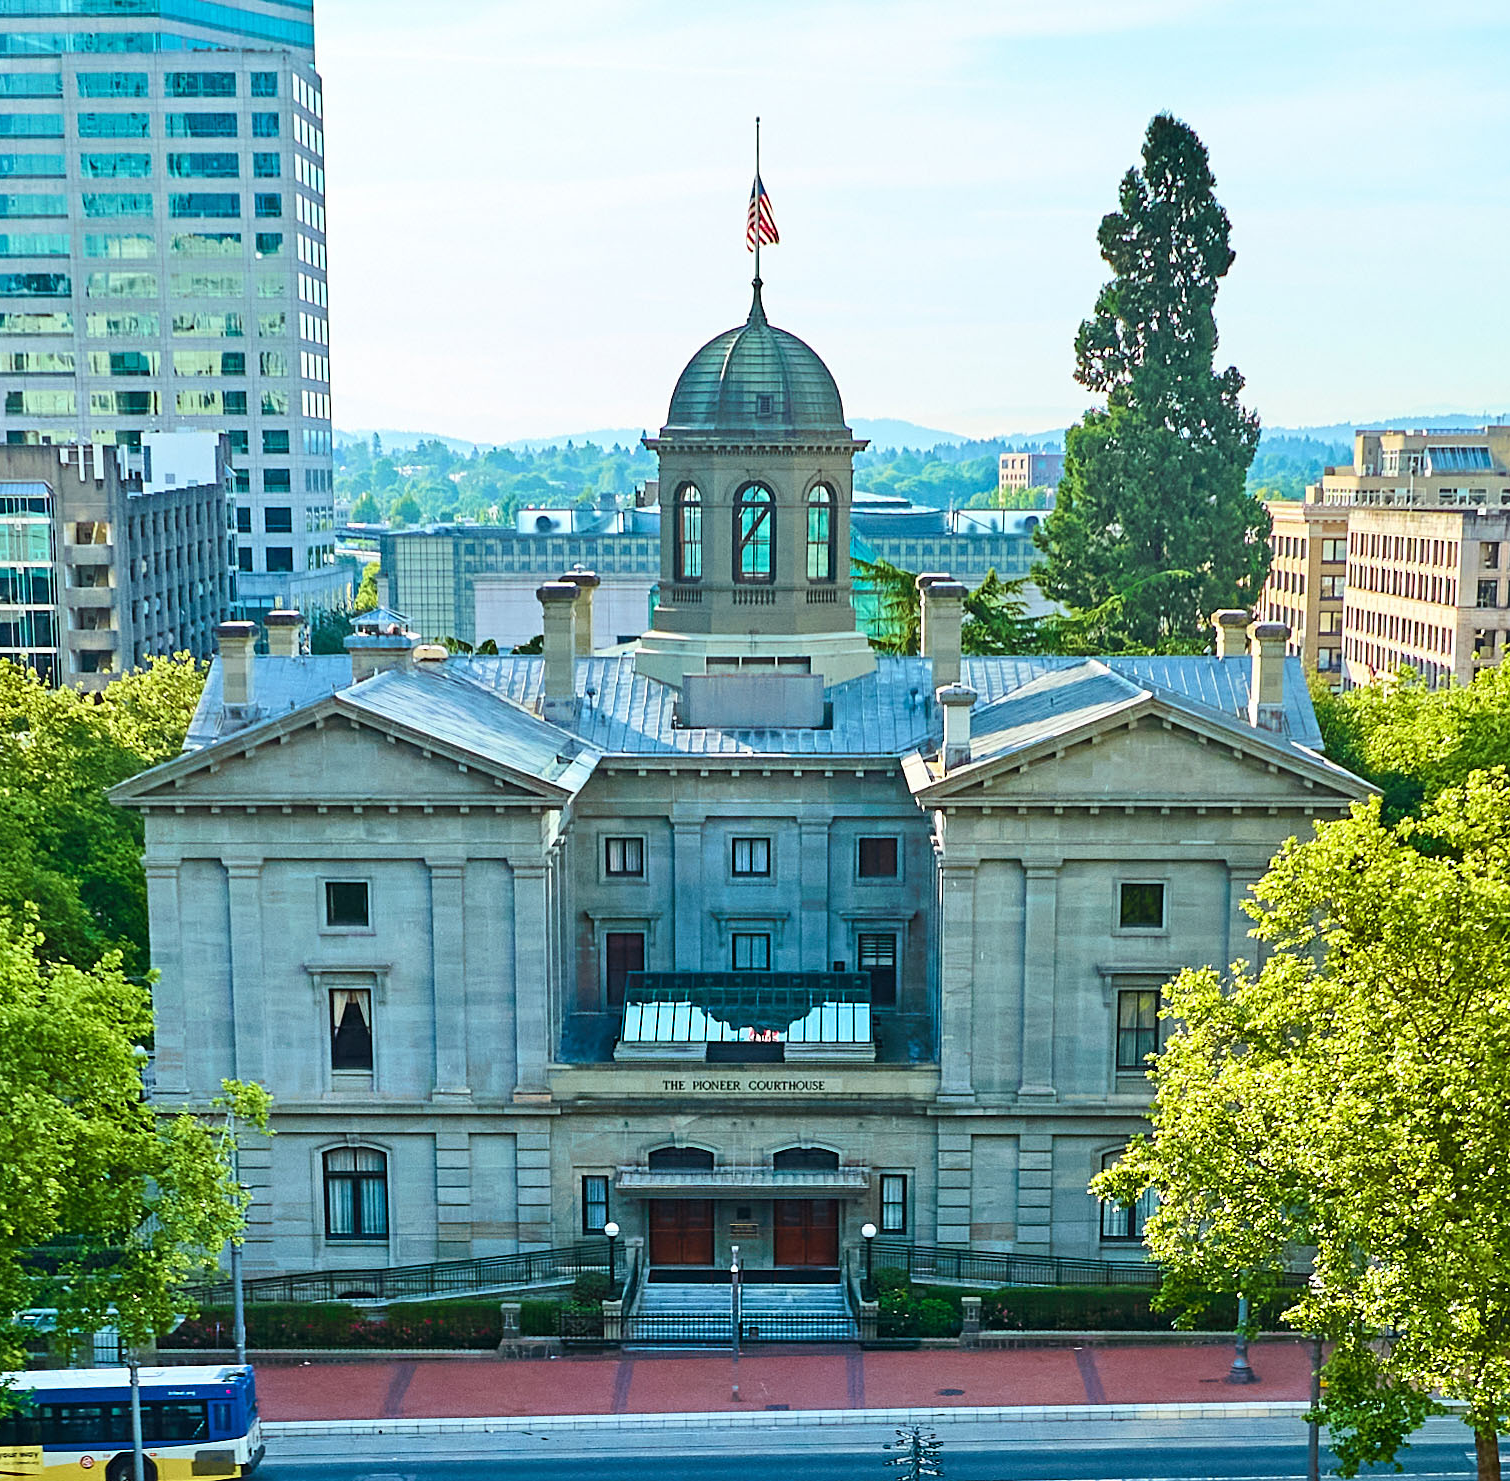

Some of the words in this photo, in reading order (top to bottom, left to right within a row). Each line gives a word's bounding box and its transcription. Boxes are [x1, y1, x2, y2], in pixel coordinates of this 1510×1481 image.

[662, 1080, 686, 1090] THE
[692, 1080, 741, 1090] PIONEER
[748, 1080, 825, 1091] COURTHOUSE
[19, 1451, 39, 1459] way
